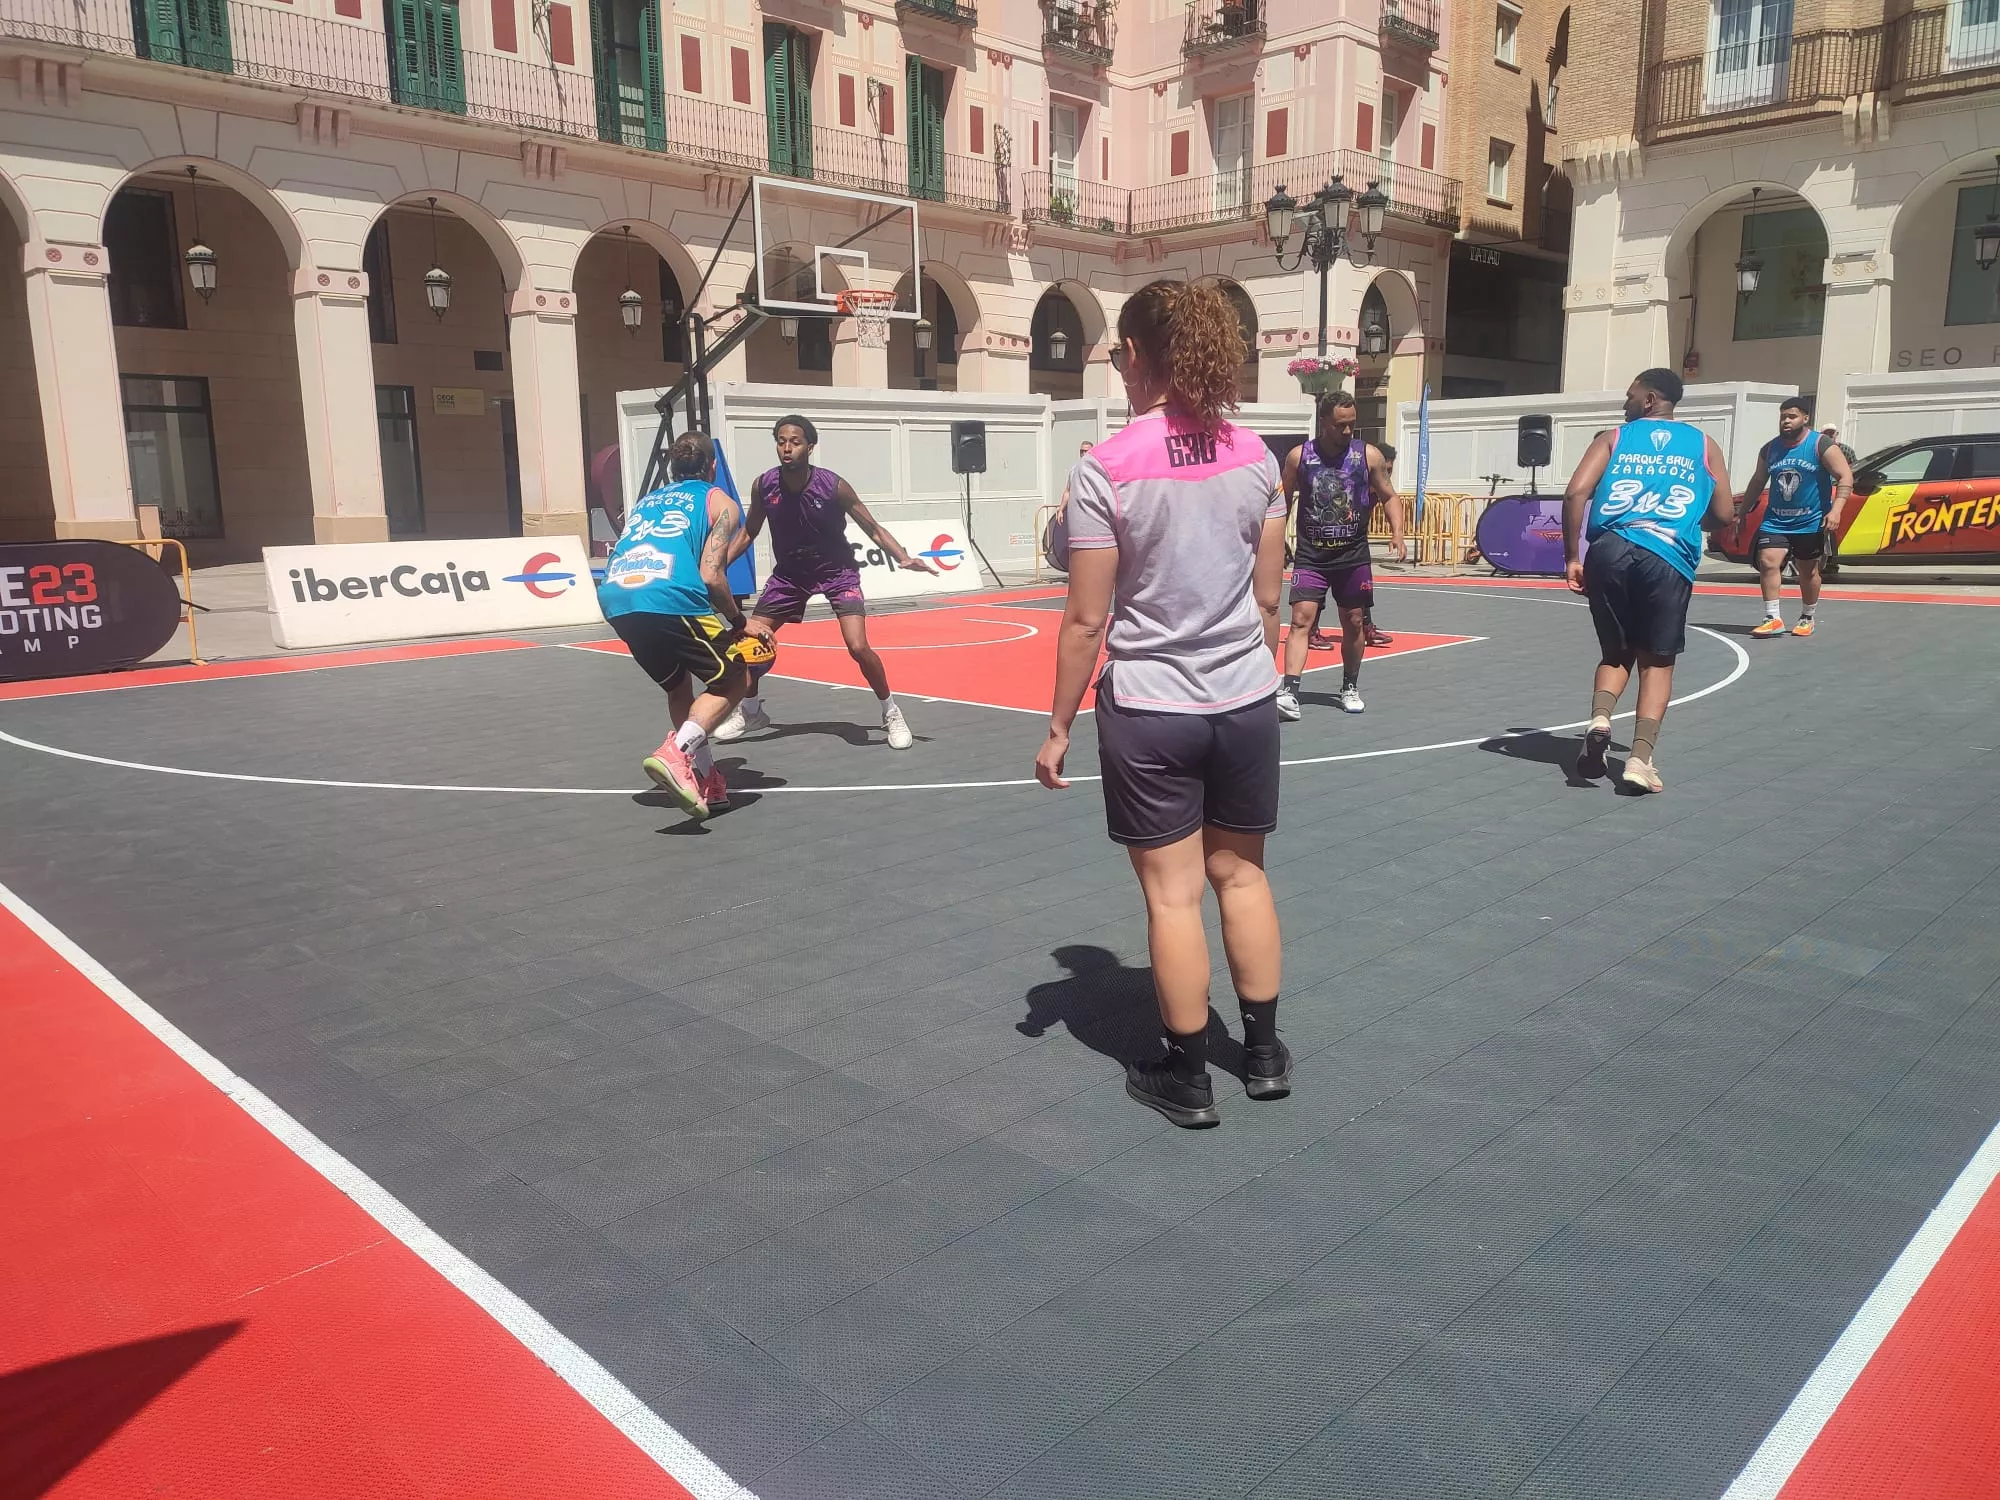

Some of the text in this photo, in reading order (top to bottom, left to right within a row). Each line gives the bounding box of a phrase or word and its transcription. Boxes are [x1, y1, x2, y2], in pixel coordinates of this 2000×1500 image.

[1618, 453, 1695, 471] PARQUE BRUIL
[1611, 464, 1695, 483] ZARAGOZA
[632, 498, 695, 513] RAGOZA
[288, 562, 490, 603] iberCaja
